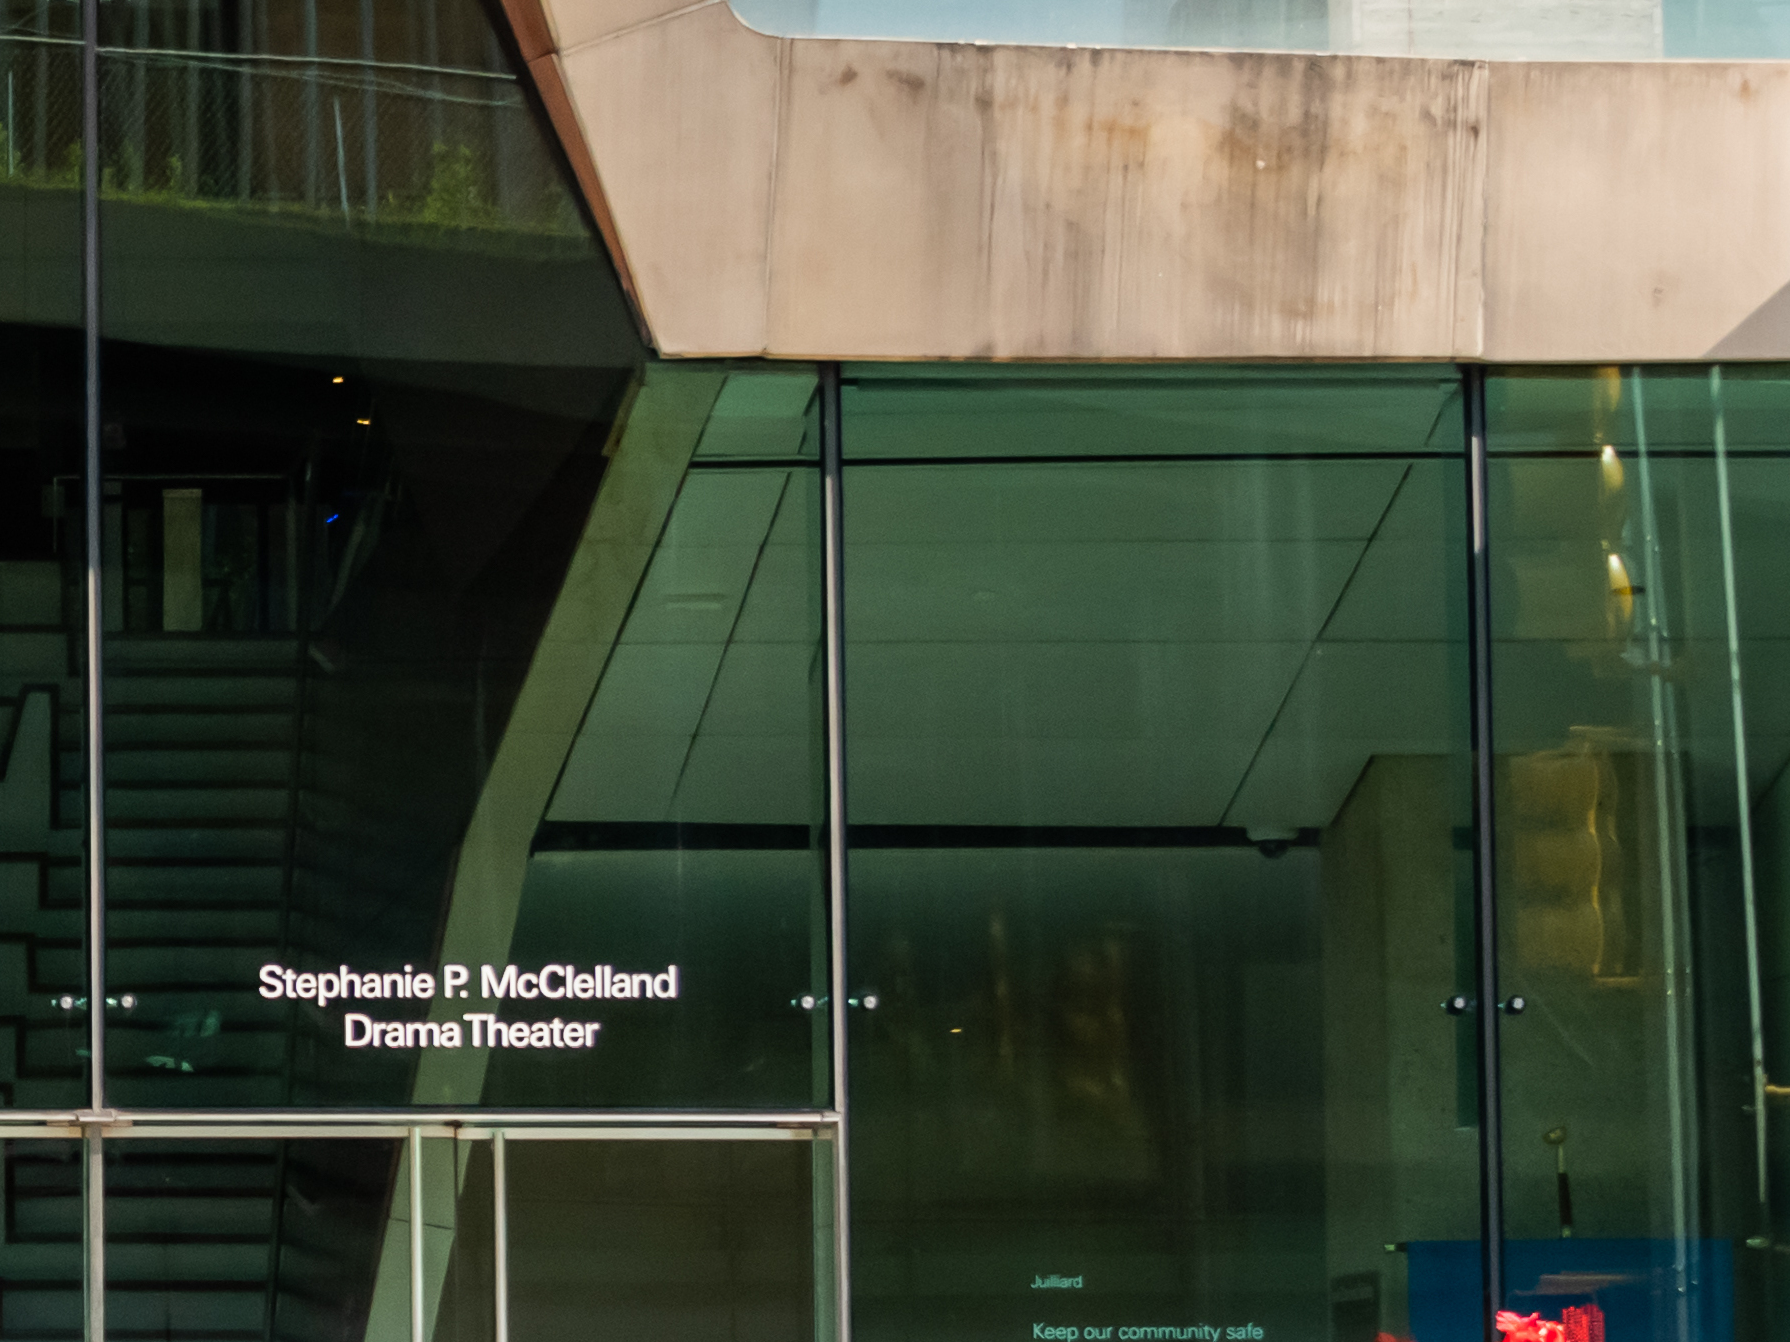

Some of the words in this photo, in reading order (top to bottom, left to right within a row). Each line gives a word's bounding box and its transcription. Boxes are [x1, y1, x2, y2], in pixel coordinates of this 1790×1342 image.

[258, 964, 436, 1007] Stephanie
[443, 964, 470, 999] P.
[480, 964, 678, 999] McClelland
[344, 1012, 463, 1048] Drama
[462, 1012, 601, 1048] Theater
[1030, 1274, 1083, 1289] Juilliard
[1032, 1322, 1079, 1342] Keep
[1083, 1325, 1114, 1340] our
[1118, 1322, 1220, 1342] community
[1225, 1321, 1264, 1340] safe
